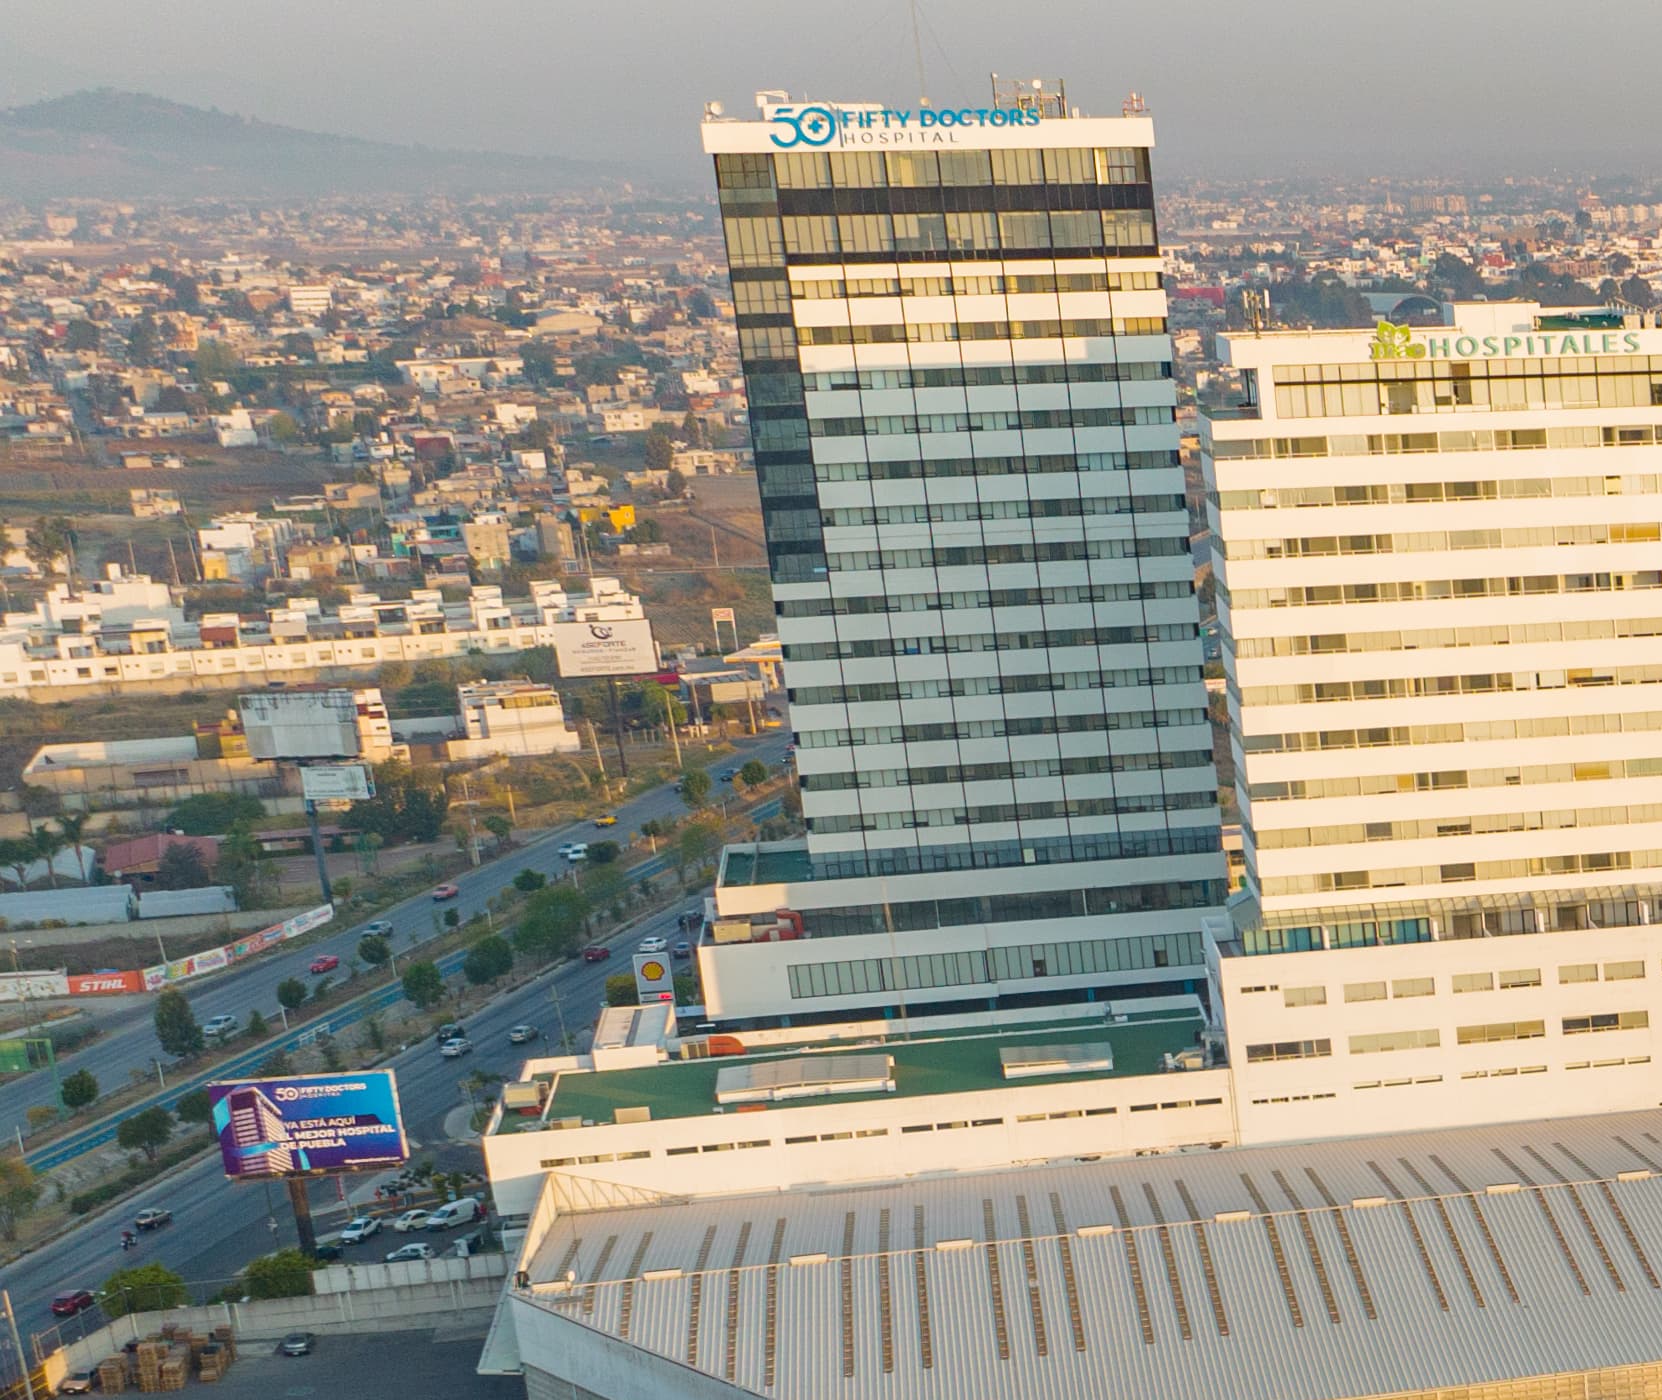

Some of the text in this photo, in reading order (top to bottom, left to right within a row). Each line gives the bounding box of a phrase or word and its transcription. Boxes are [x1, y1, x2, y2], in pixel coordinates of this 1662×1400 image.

[842, 107, 1041, 129] FIFTY DOCTORS
[769, 106, 836, 148] 50
[843, 131, 960, 145] HOSPITAL
[1429, 332, 1641, 358] HOSPITALES
[80, 978, 127, 993] STIHL
[300, 1117, 327, 1129] ESTÁ
[328, 1115, 356, 1127] AQUÍ
[294, 1129, 336, 1141] MEJOR
[338, 1124, 397, 1136] HOSPITAL
[299, 1137, 347, 1150] PUEBLA
